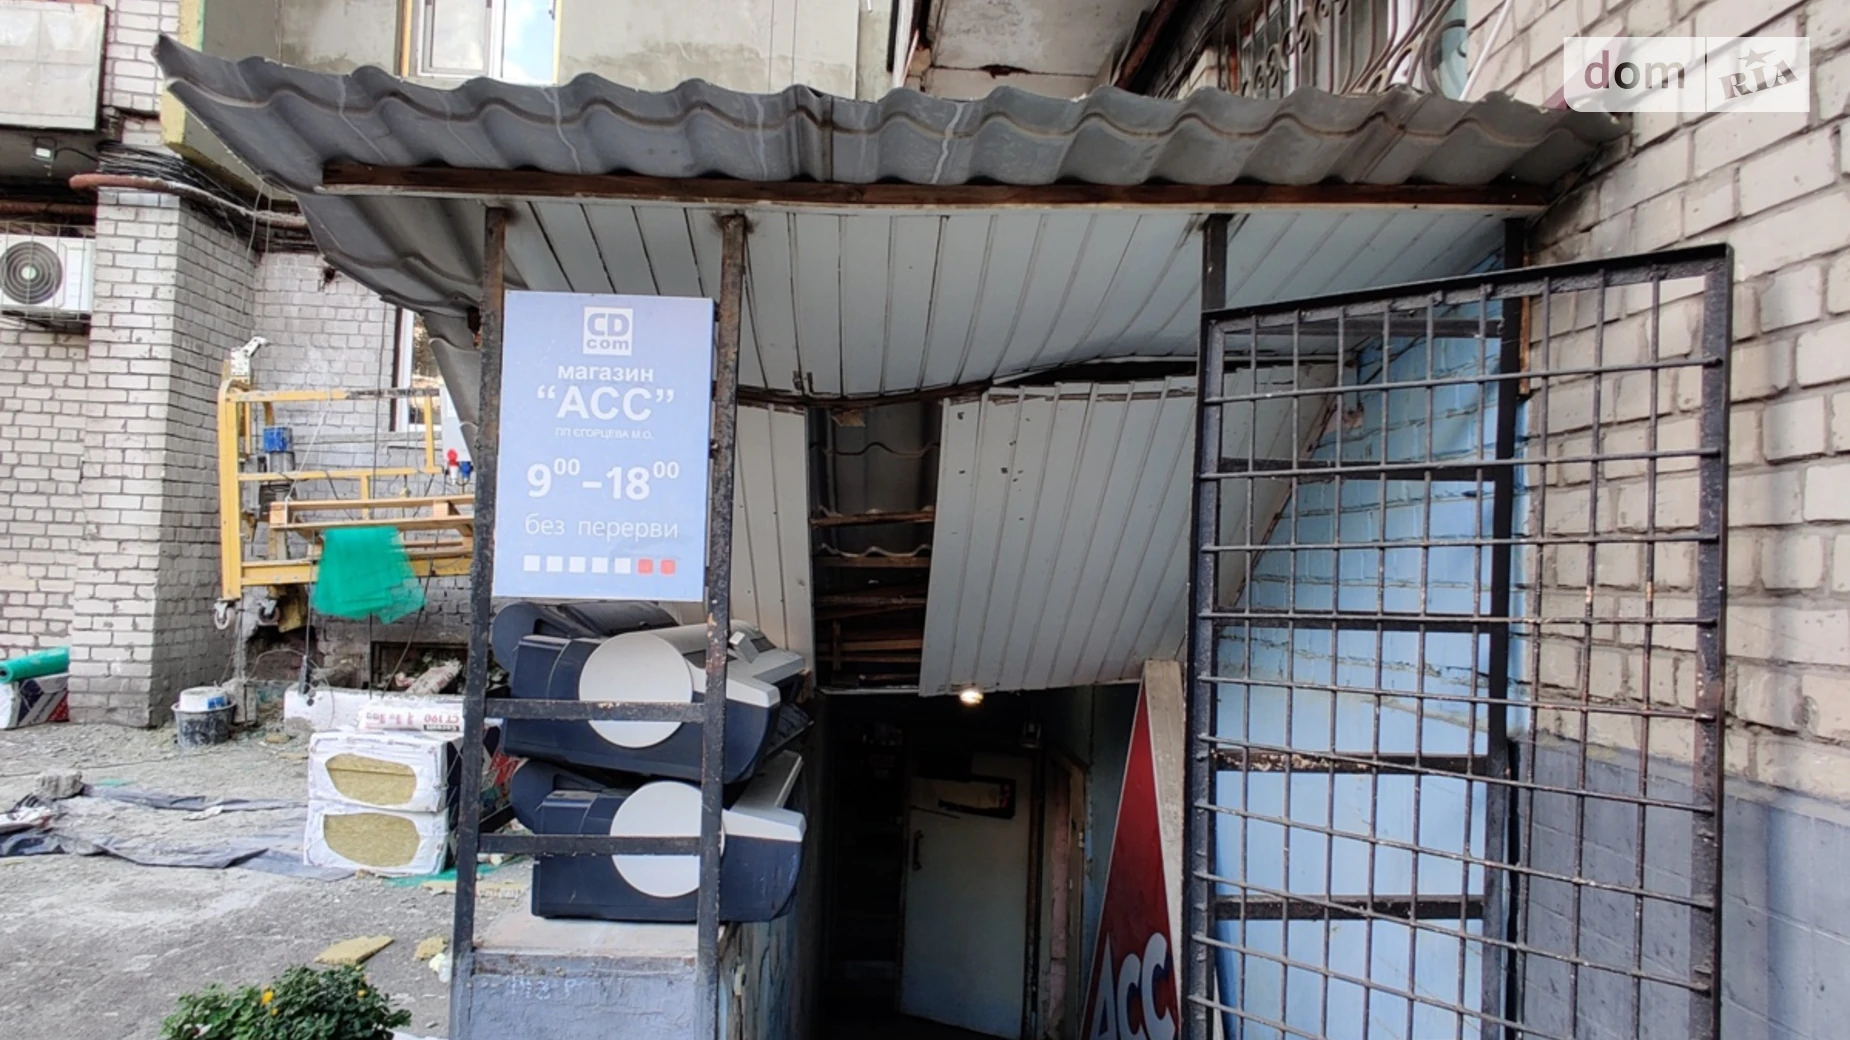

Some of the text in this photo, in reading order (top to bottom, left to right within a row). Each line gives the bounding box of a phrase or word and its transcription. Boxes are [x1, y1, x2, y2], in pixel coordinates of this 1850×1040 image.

[587, 313, 630, 337] CD
[586, 338, 630, 351] com
[557, 365, 654, 382] магазин
[524, 513, 679, 539] без перерви
